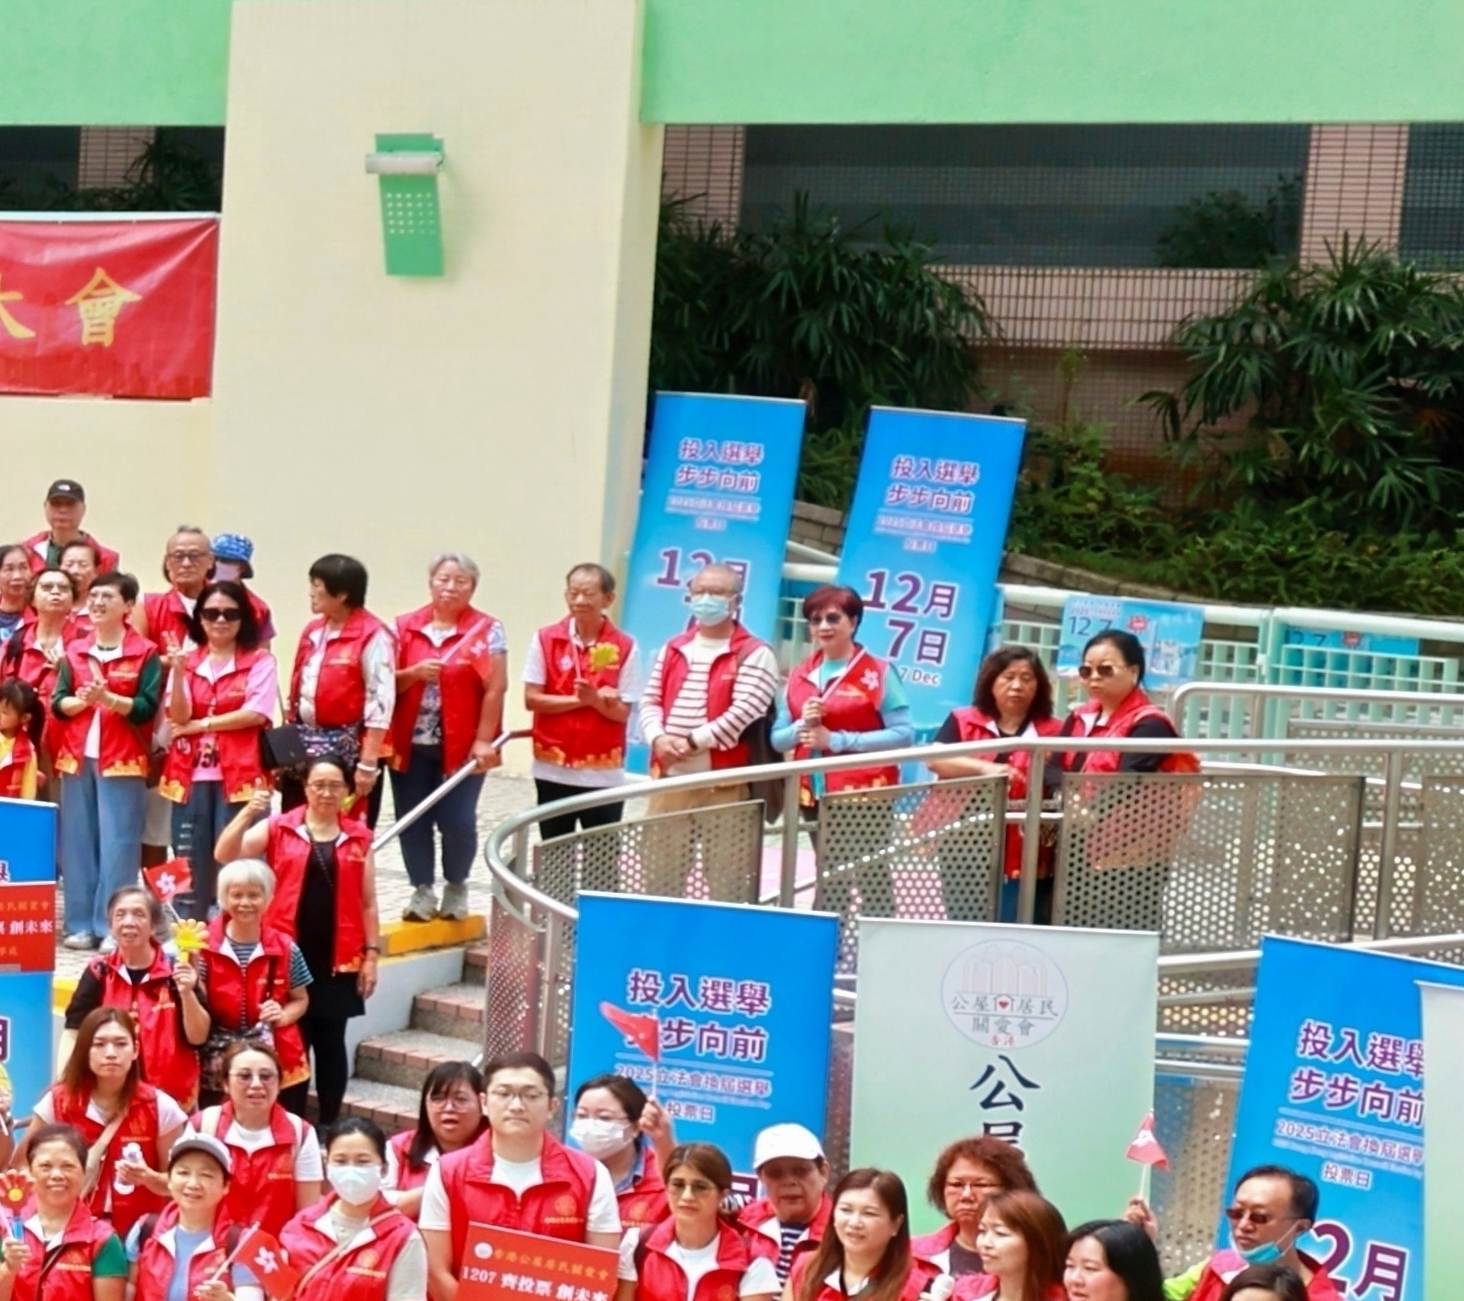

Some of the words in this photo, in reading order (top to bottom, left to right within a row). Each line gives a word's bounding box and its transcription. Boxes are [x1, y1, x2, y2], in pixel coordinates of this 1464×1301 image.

[679, 438, 763, 466] 投入選舉
[676, 467, 760, 491] 步步向前
[892, 456, 979, 484] 投入選舉
[889, 485, 975, 513] 步步向前
[862, 569, 958, 620] 12月
[887, 619, 948, 666] 7日
[912, 669, 940, 686] Dec
[628, 969, 770, 1017] 投入選舉
[627, 1013, 766, 1062] 步向前
[667, 1103, 714, 1122] 投票日
[1324, 1164, 1370, 1188] 投票日
[493, 1248, 608, 1280] 香港公屋居民關愛會
[462, 1266, 496, 1283] 1207
[501, 1273, 551, 1295] 齊投票
